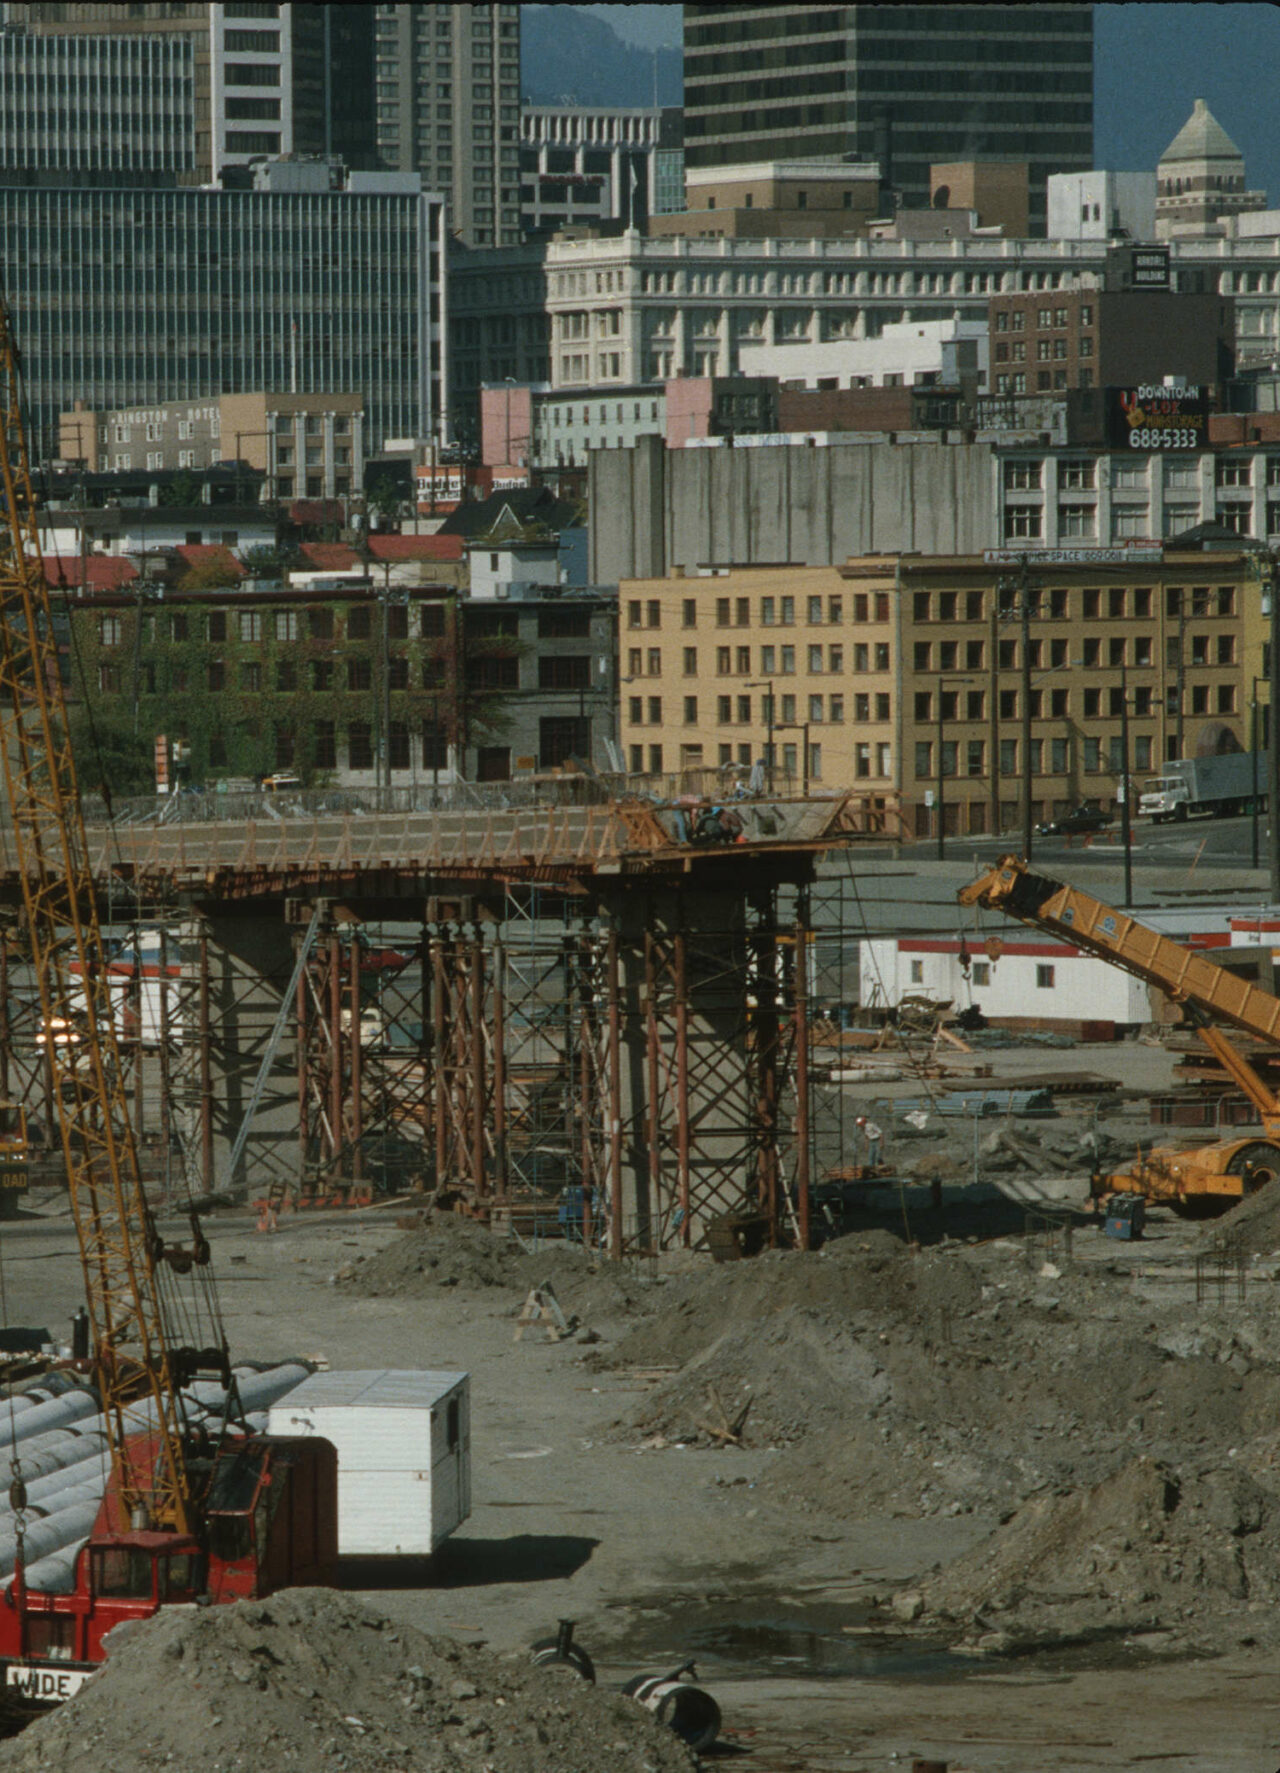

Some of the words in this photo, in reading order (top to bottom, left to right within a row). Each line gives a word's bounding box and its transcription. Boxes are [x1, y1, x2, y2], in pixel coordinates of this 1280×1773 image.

[1136, 270, 1165, 281] BUILDING
[1138, 386, 1199, 400] DOWNTOWN
[187, 407, 220, 420] HOTEL
[1129, 428, 1197, 448] 688-5333
[1051, 551, 1080, 562] SPACE
[13, 1673, 70, 1696] WIDE
